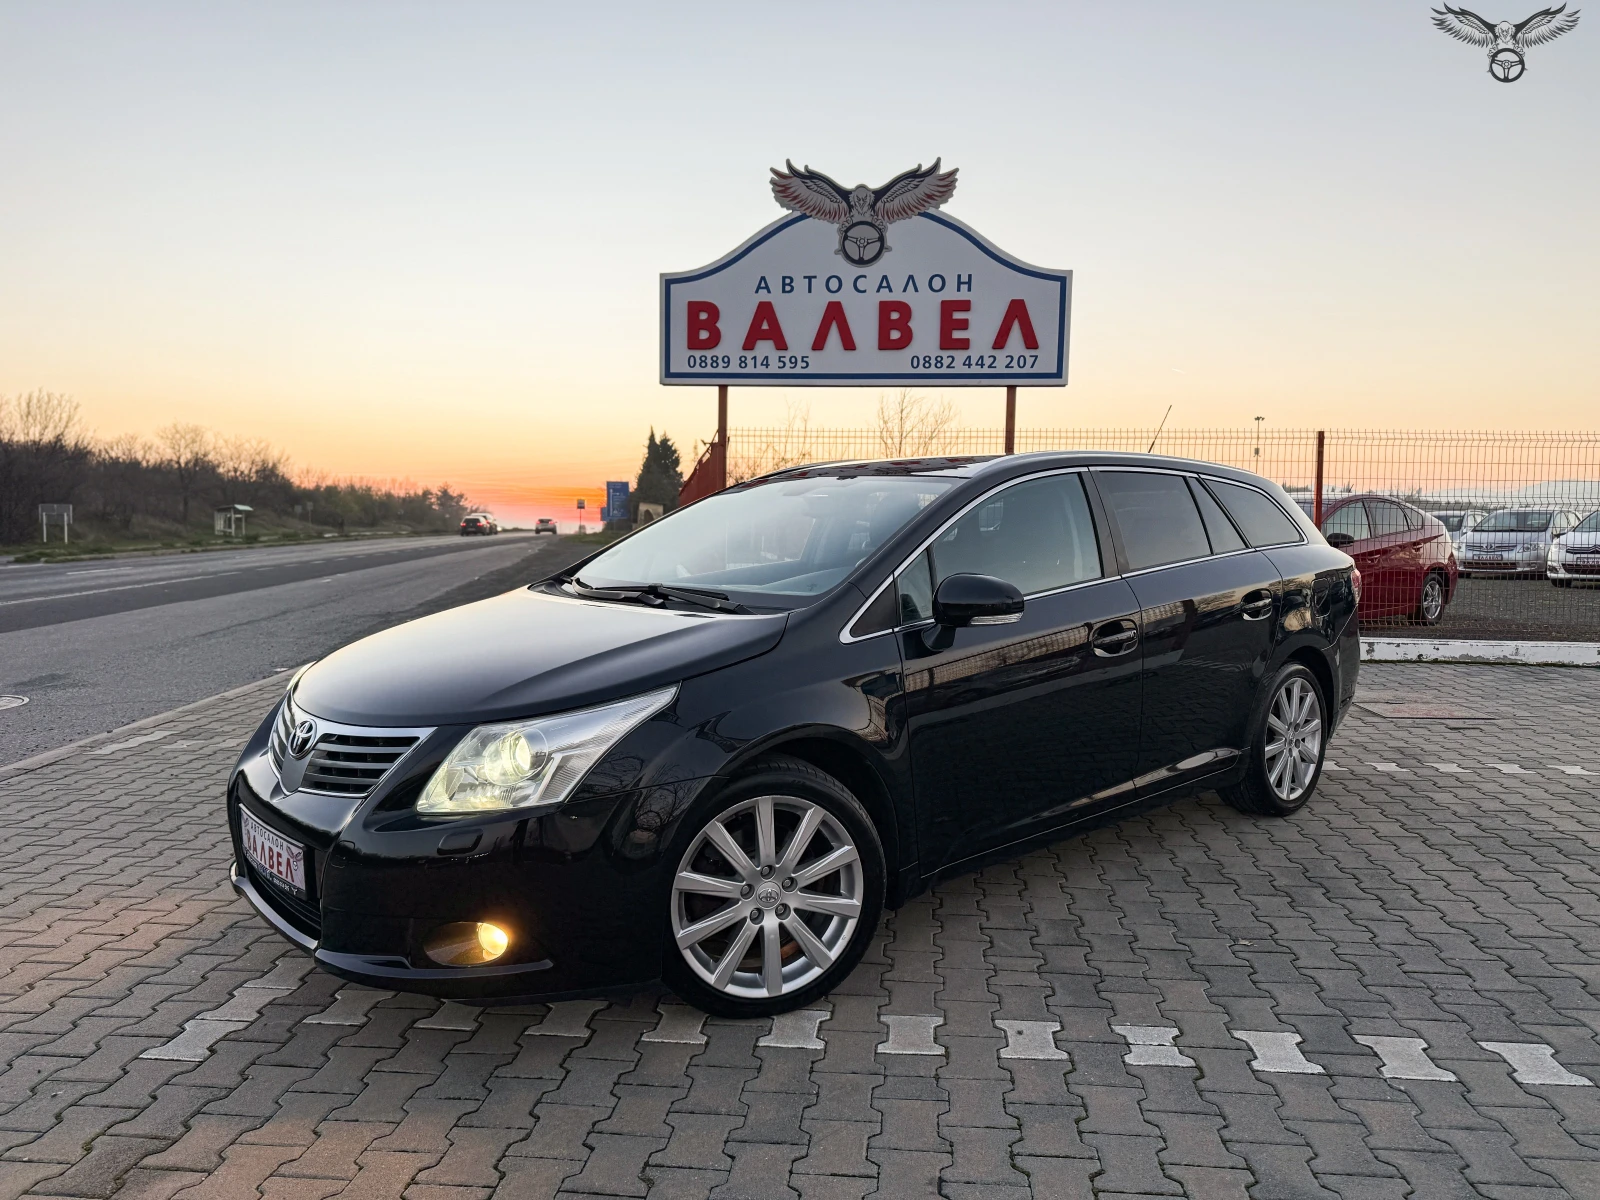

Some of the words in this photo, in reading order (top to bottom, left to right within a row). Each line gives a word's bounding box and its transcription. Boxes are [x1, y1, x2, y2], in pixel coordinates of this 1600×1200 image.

[754, 273, 974, 295] АВТОСАЛОН
[686, 299, 1040, 351] ВАЛВЕЛ
[687, 354, 731, 369] 0889
[738, 354, 771, 369] 814
[777, 355, 810, 370] 595
[910, 354, 956, 369] 0882
[962, 354, 998, 369] 442
[1004, 354, 1039, 369] 207
